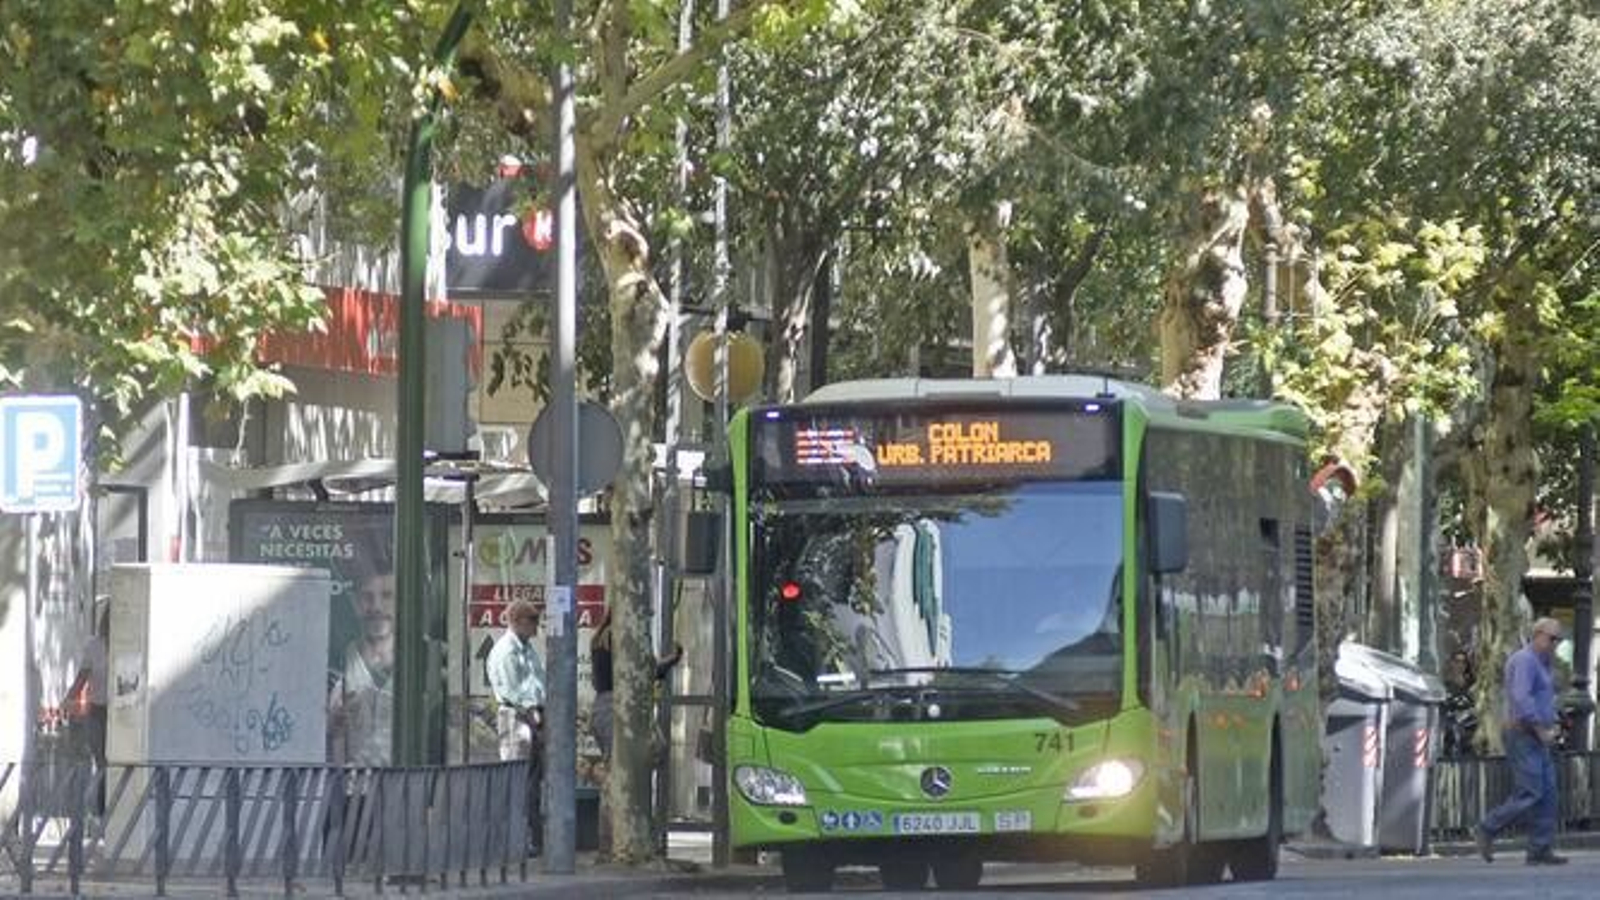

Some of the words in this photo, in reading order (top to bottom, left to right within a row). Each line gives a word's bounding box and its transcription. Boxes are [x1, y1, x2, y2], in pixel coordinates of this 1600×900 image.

[445, 213, 517, 256] ur
[929, 421, 998, 442] COLON
[16, 411, 65, 499] P
[877, 442, 925, 466] URB.
[929, 441, 1051, 463] PATRIARCA
[288, 523, 345, 540] VECES
[259, 541, 355, 559] NECESITAS
[512, 537, 593, 566] MS
[1034, 732, 1075, 754] 741
